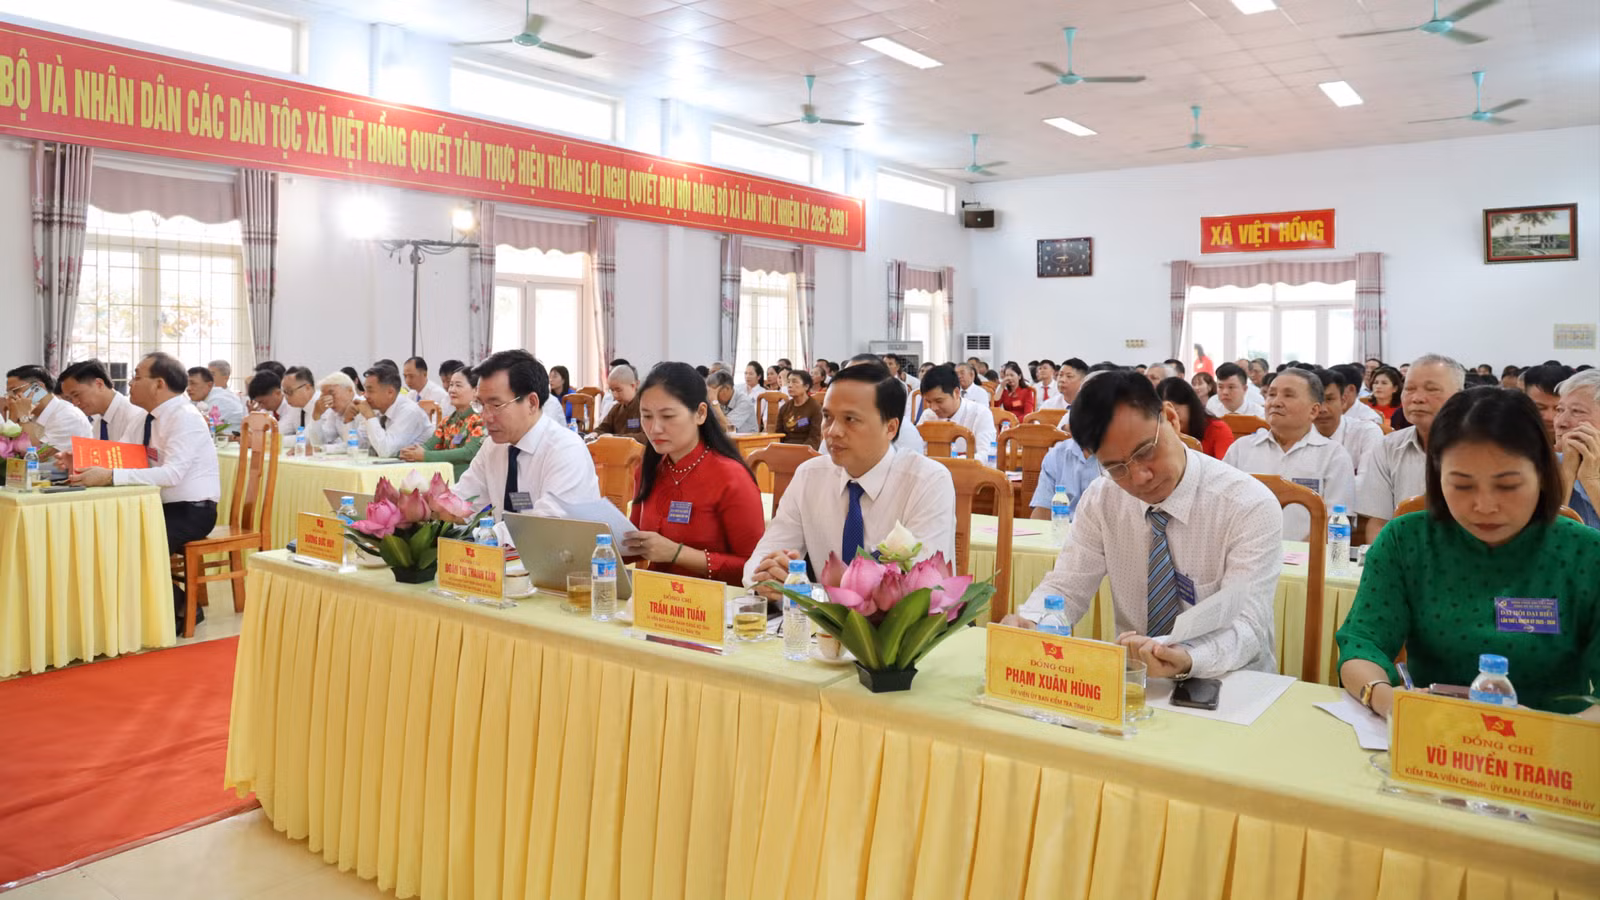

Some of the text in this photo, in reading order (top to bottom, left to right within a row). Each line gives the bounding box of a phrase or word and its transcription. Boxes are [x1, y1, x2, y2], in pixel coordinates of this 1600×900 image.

[0, 48, 31, 121] BỘ
[38, 54, 68, 117] VÀ
[74, 65, 135, 126] NHÂN
[140, 74, 181, 133] DÂN
[187, 82, 224, 140] CÁC
[229, 90, 266, 146] DÂN
[270, 97, 302, 159] TỘC
[306, 105, 328, 155] XÃ
[332, 110, 364, 168] VIỆT
[411, 122, 452, 174] QUYẾT
[454, 131, 482, 178] TÂM
[485, 143, 515, 190] THỰC
[518, 144, 545, 194] HIỆN
[547, 144, 582, 194] THẮNG
[585, 160, 601, 204] LỢI
[603, 165, 627, 208] NGHỊ
[629, 163, 658, 206] QUYẾT
[677, 173, 691, 217] HỘI
[729, 184, 740, 219] XÃ
[1210, 215, 1325, 248] XÃ VIỆT HỒNG
[669, 605, 685, 618] ANH
[1030, 658, 1075, 674] ĐỒNG CHÍ
[1005, 666, 1101, 701] PHẠM XUÂN HÙNG
[1462, 734, 1534, 756] ĐỒNG CHÍ
[1427, 745, 1573, 791] VŨ HUYỀN TRANG
[1425, 770, 1439, 779] TRA
[1441, 772, 1458, 784] VIÊN
[1502, 786, 1520, 796] BAN
[1545, 793, 1560, 802] TRA
